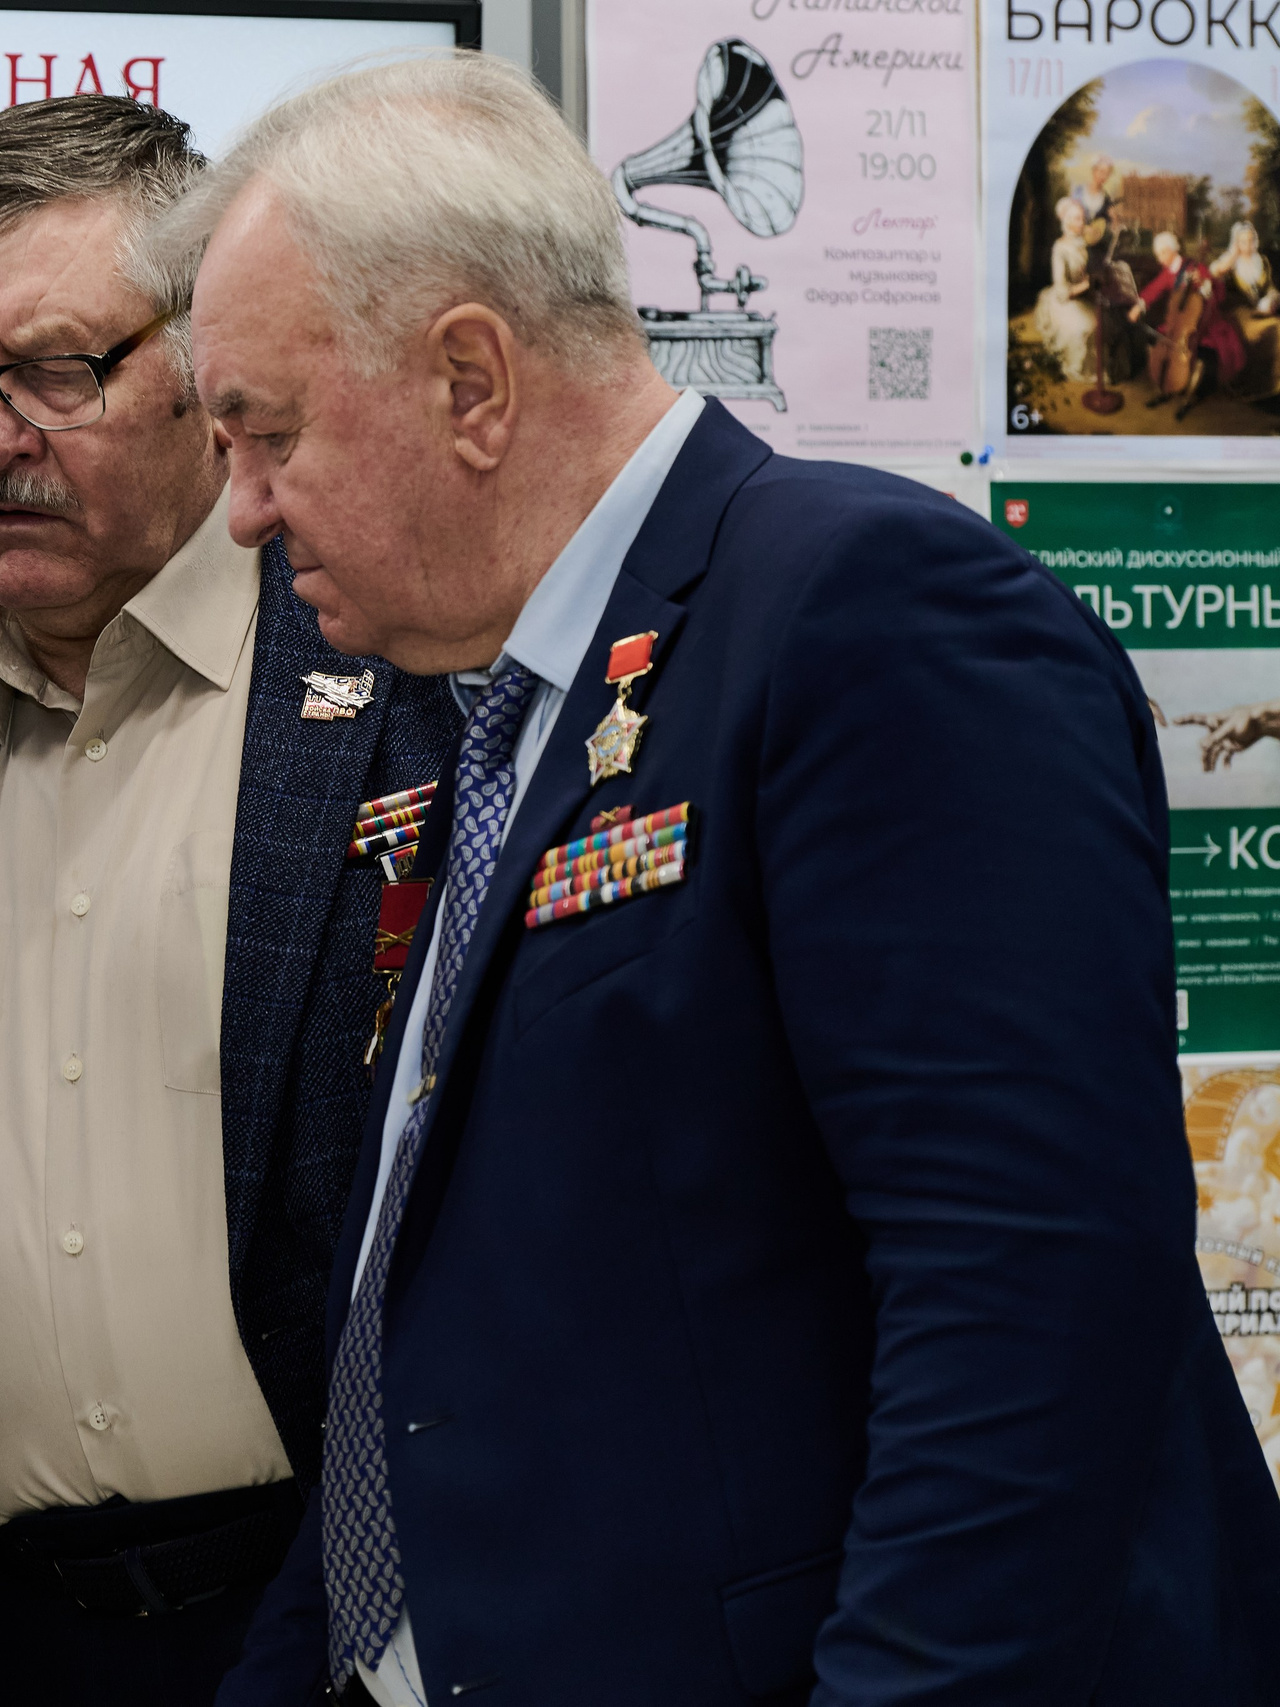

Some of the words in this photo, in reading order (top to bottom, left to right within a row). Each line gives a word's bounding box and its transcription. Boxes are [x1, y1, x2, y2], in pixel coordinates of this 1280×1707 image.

[791, 32, 963, 87] Америки
[1008, 56, 1064, 98] 17/11
[865, 105, 927, 139] 21/11
[858, 151, 937, 181] 19:00
[1011, 403, 1044, 430] 6+
[332, 706, 354, 716] ПВО
